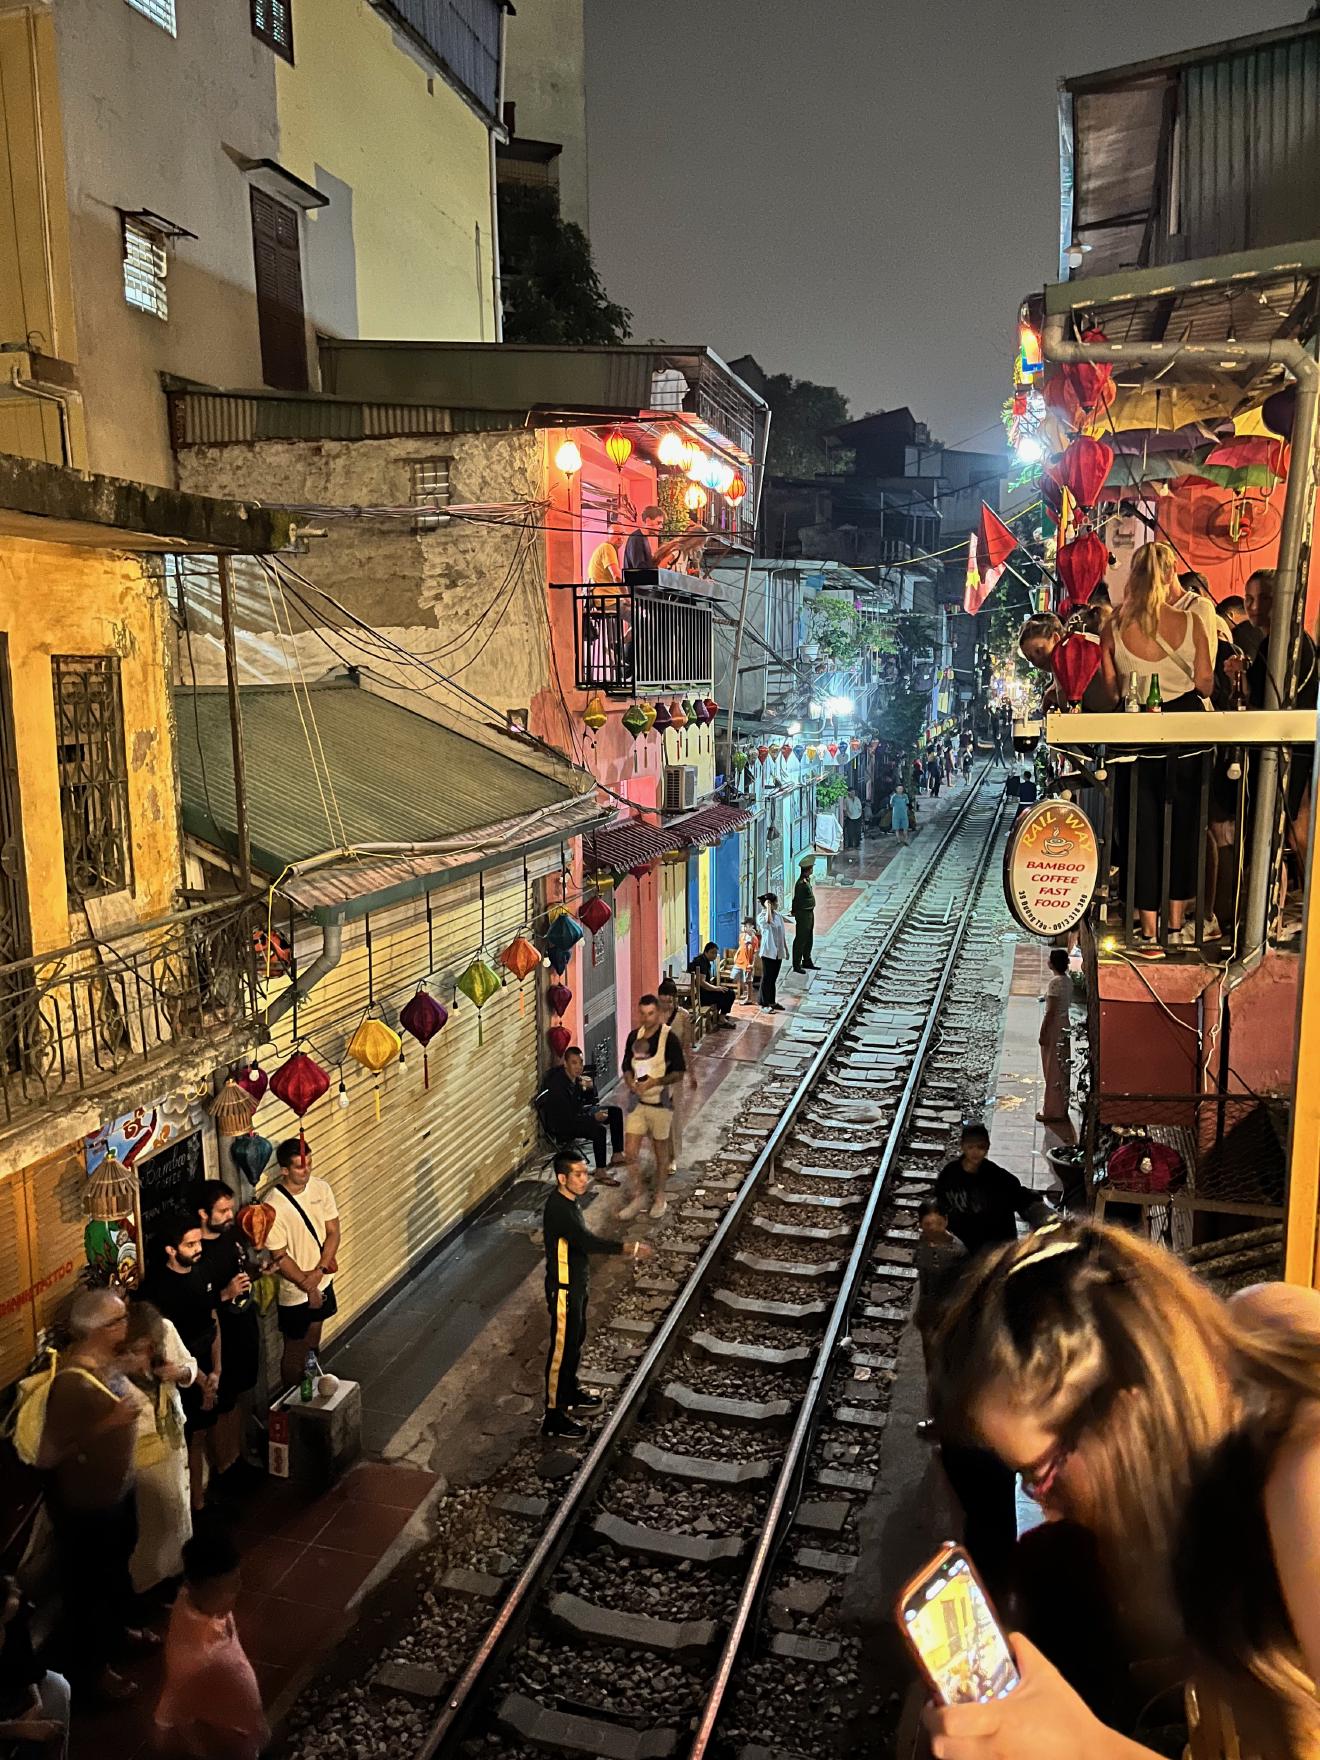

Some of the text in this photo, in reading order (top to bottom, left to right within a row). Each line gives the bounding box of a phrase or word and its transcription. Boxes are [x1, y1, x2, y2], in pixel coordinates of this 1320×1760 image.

[1023, 811, 1093, 853] RAIL WAY
[1026, 861, 1085, 872] BAMBOO
[1031, 873, 1079, 884] COFFEE
[1038, 886, 1071, 896] FAST
[1034, 898, 1071, 908] FOOD
[1053, 918, 1070, 931] 0913
